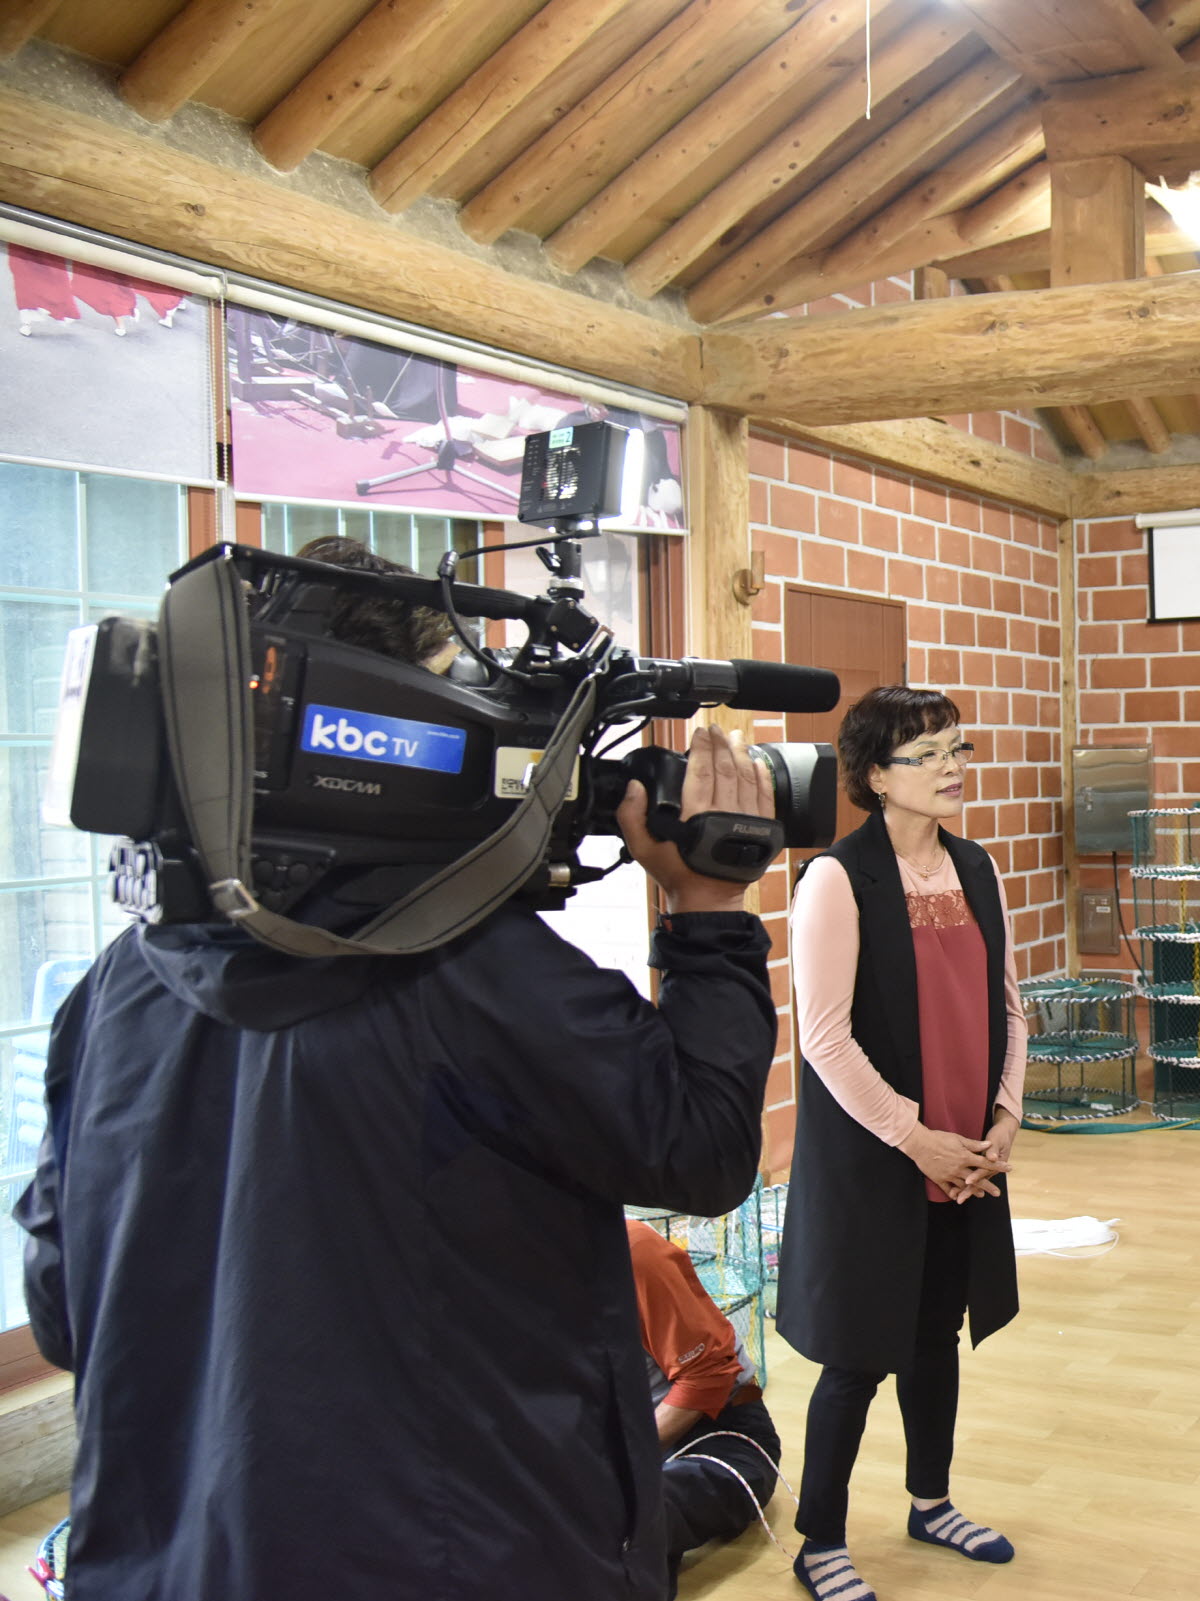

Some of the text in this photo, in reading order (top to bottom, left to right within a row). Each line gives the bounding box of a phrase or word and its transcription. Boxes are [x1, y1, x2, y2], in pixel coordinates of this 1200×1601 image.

[310, 713, 419, 758] kbc TV
[313, 775, 382, 795] XDCAM
